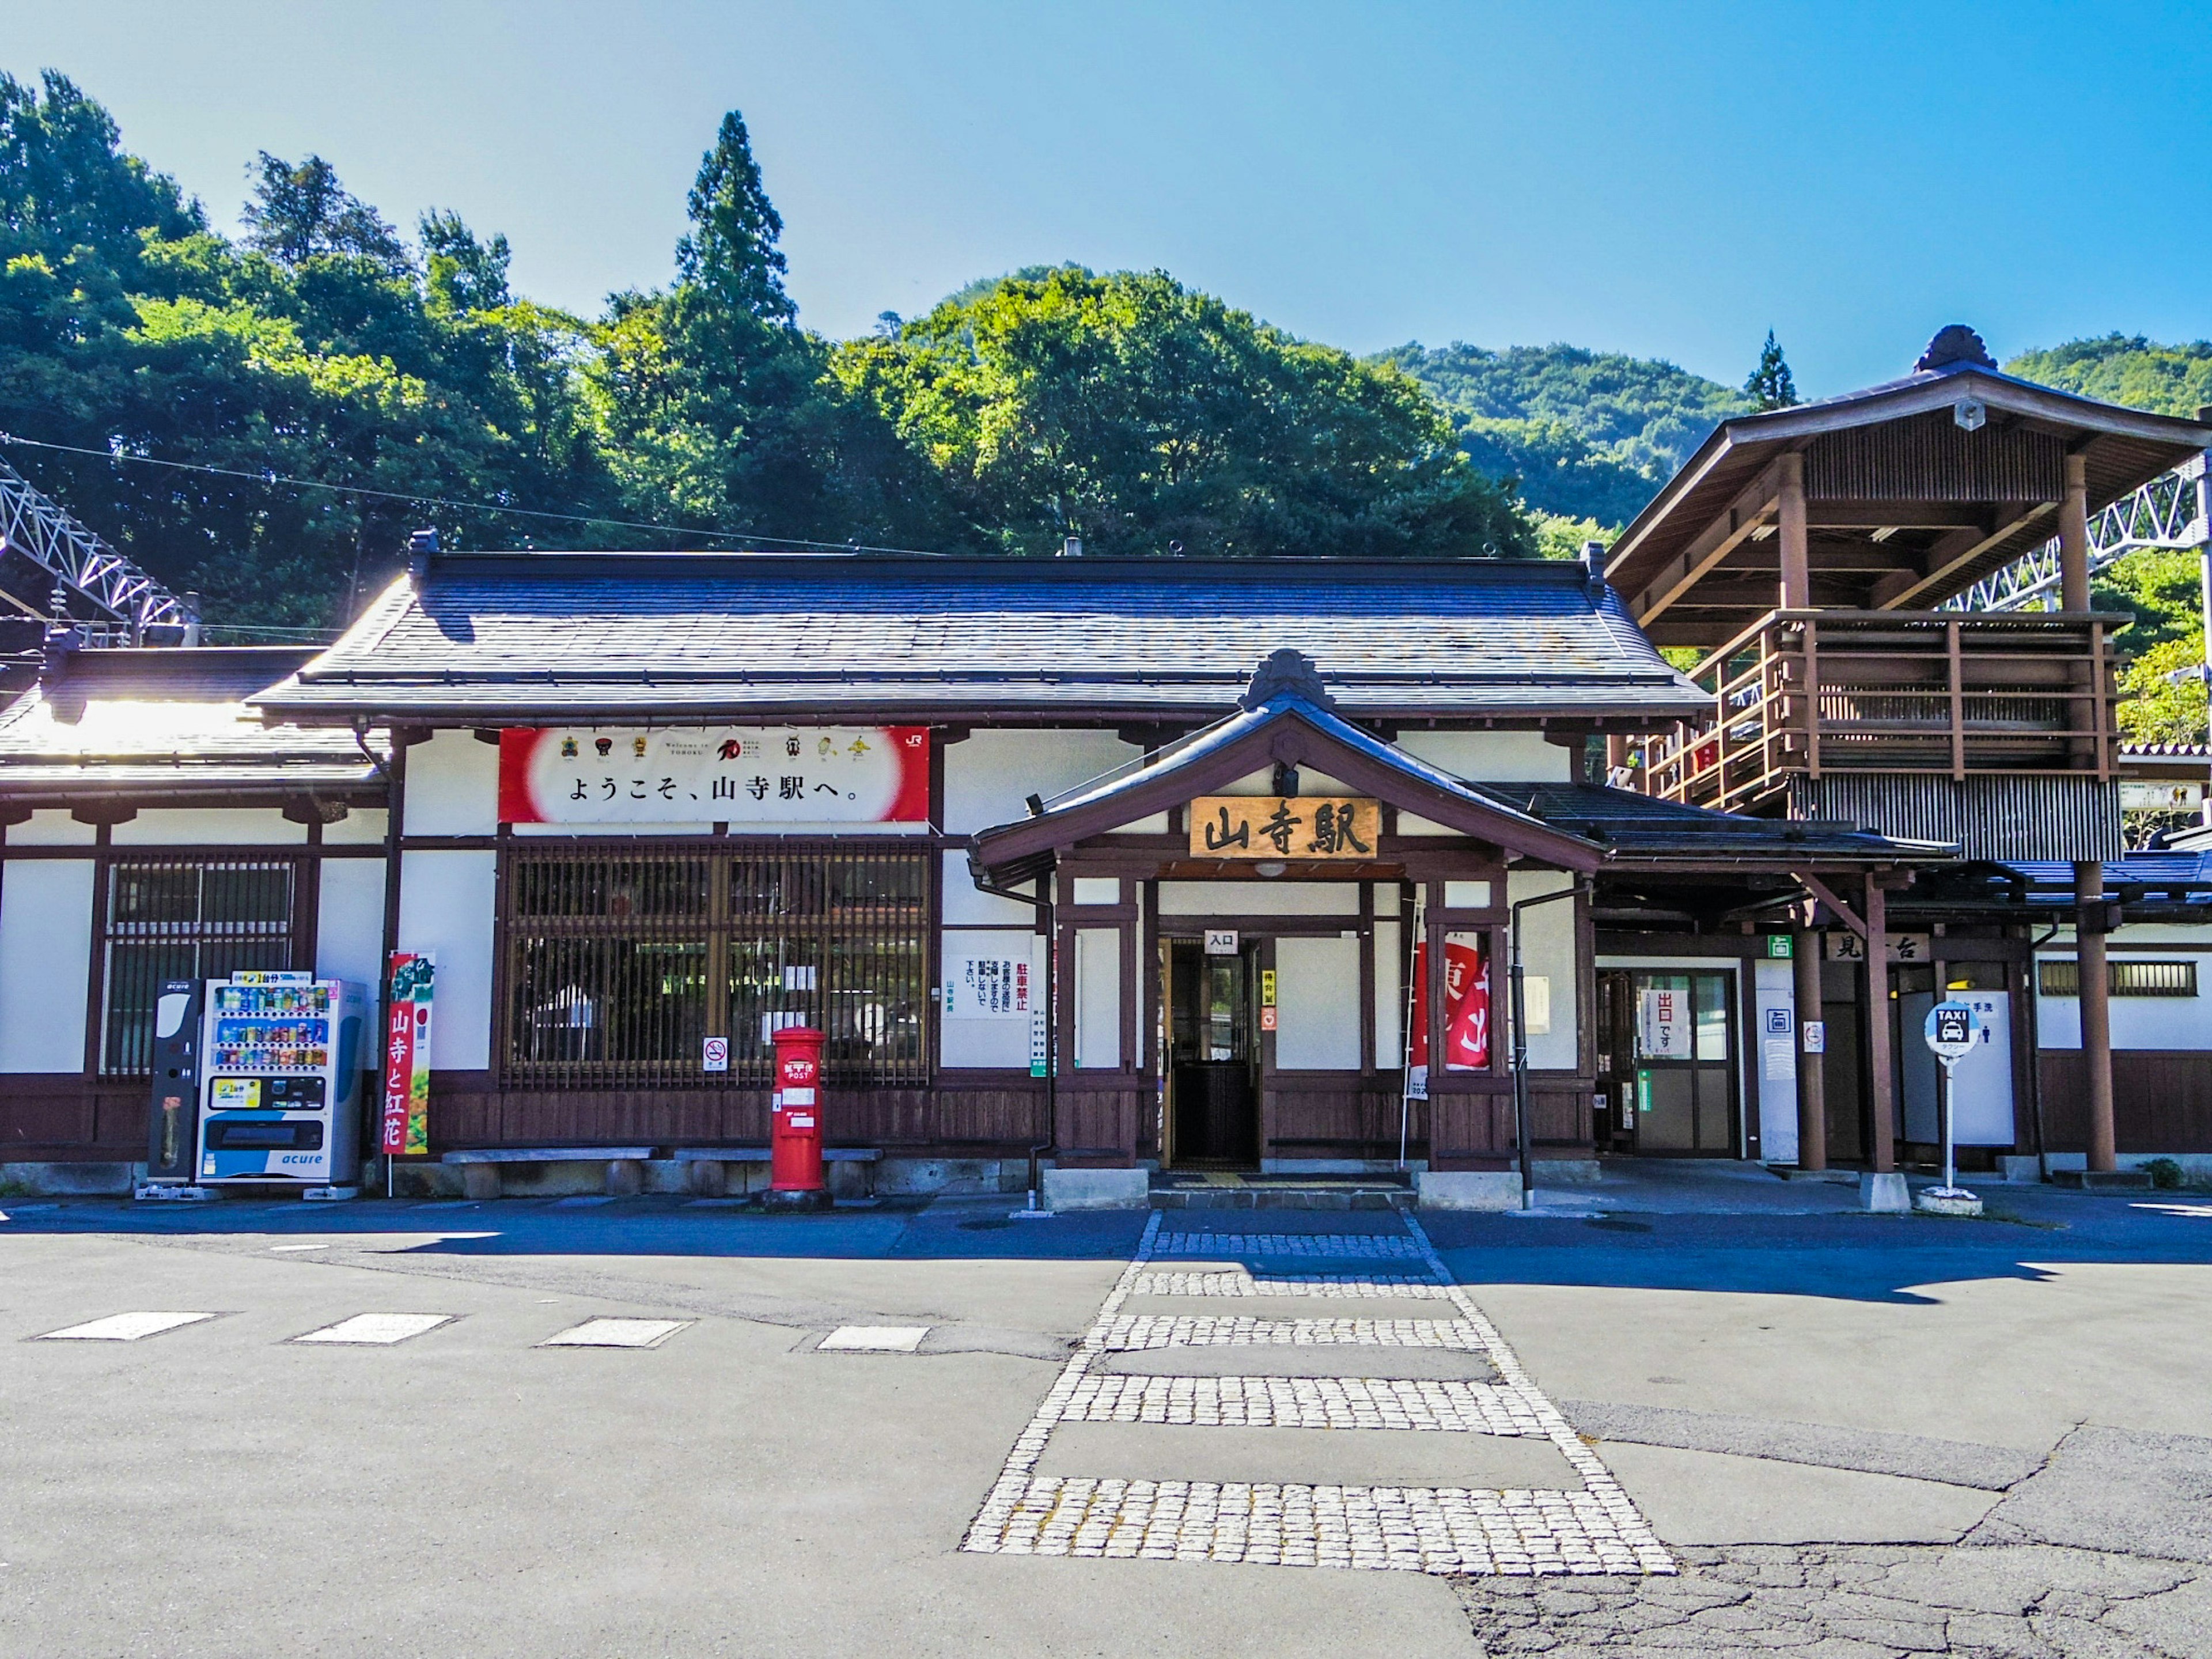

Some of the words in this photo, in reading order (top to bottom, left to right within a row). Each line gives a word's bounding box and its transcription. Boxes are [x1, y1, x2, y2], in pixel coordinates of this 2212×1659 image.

[906, 734, 922, 744] JR
[570, 776, 856, 801] ようこそ、山寺駅へ。
[1206, 799, 1370, 854] 山寺駅
[1210, 934, 1233, 945] 入口
[1837, 935, 1916, 959] 見台
[1016, 963, 1028, 1010] 駐車禁止
[1938, 1010, 1967, 1020] TAXI
[1964, 1001, 1993, 1012] 手洗
[1658, 993, 1672, 1047] 出口です
[384, 1010, 409, 1146] 山寺と紅花
[282, 1155, 323, 1164] acure
